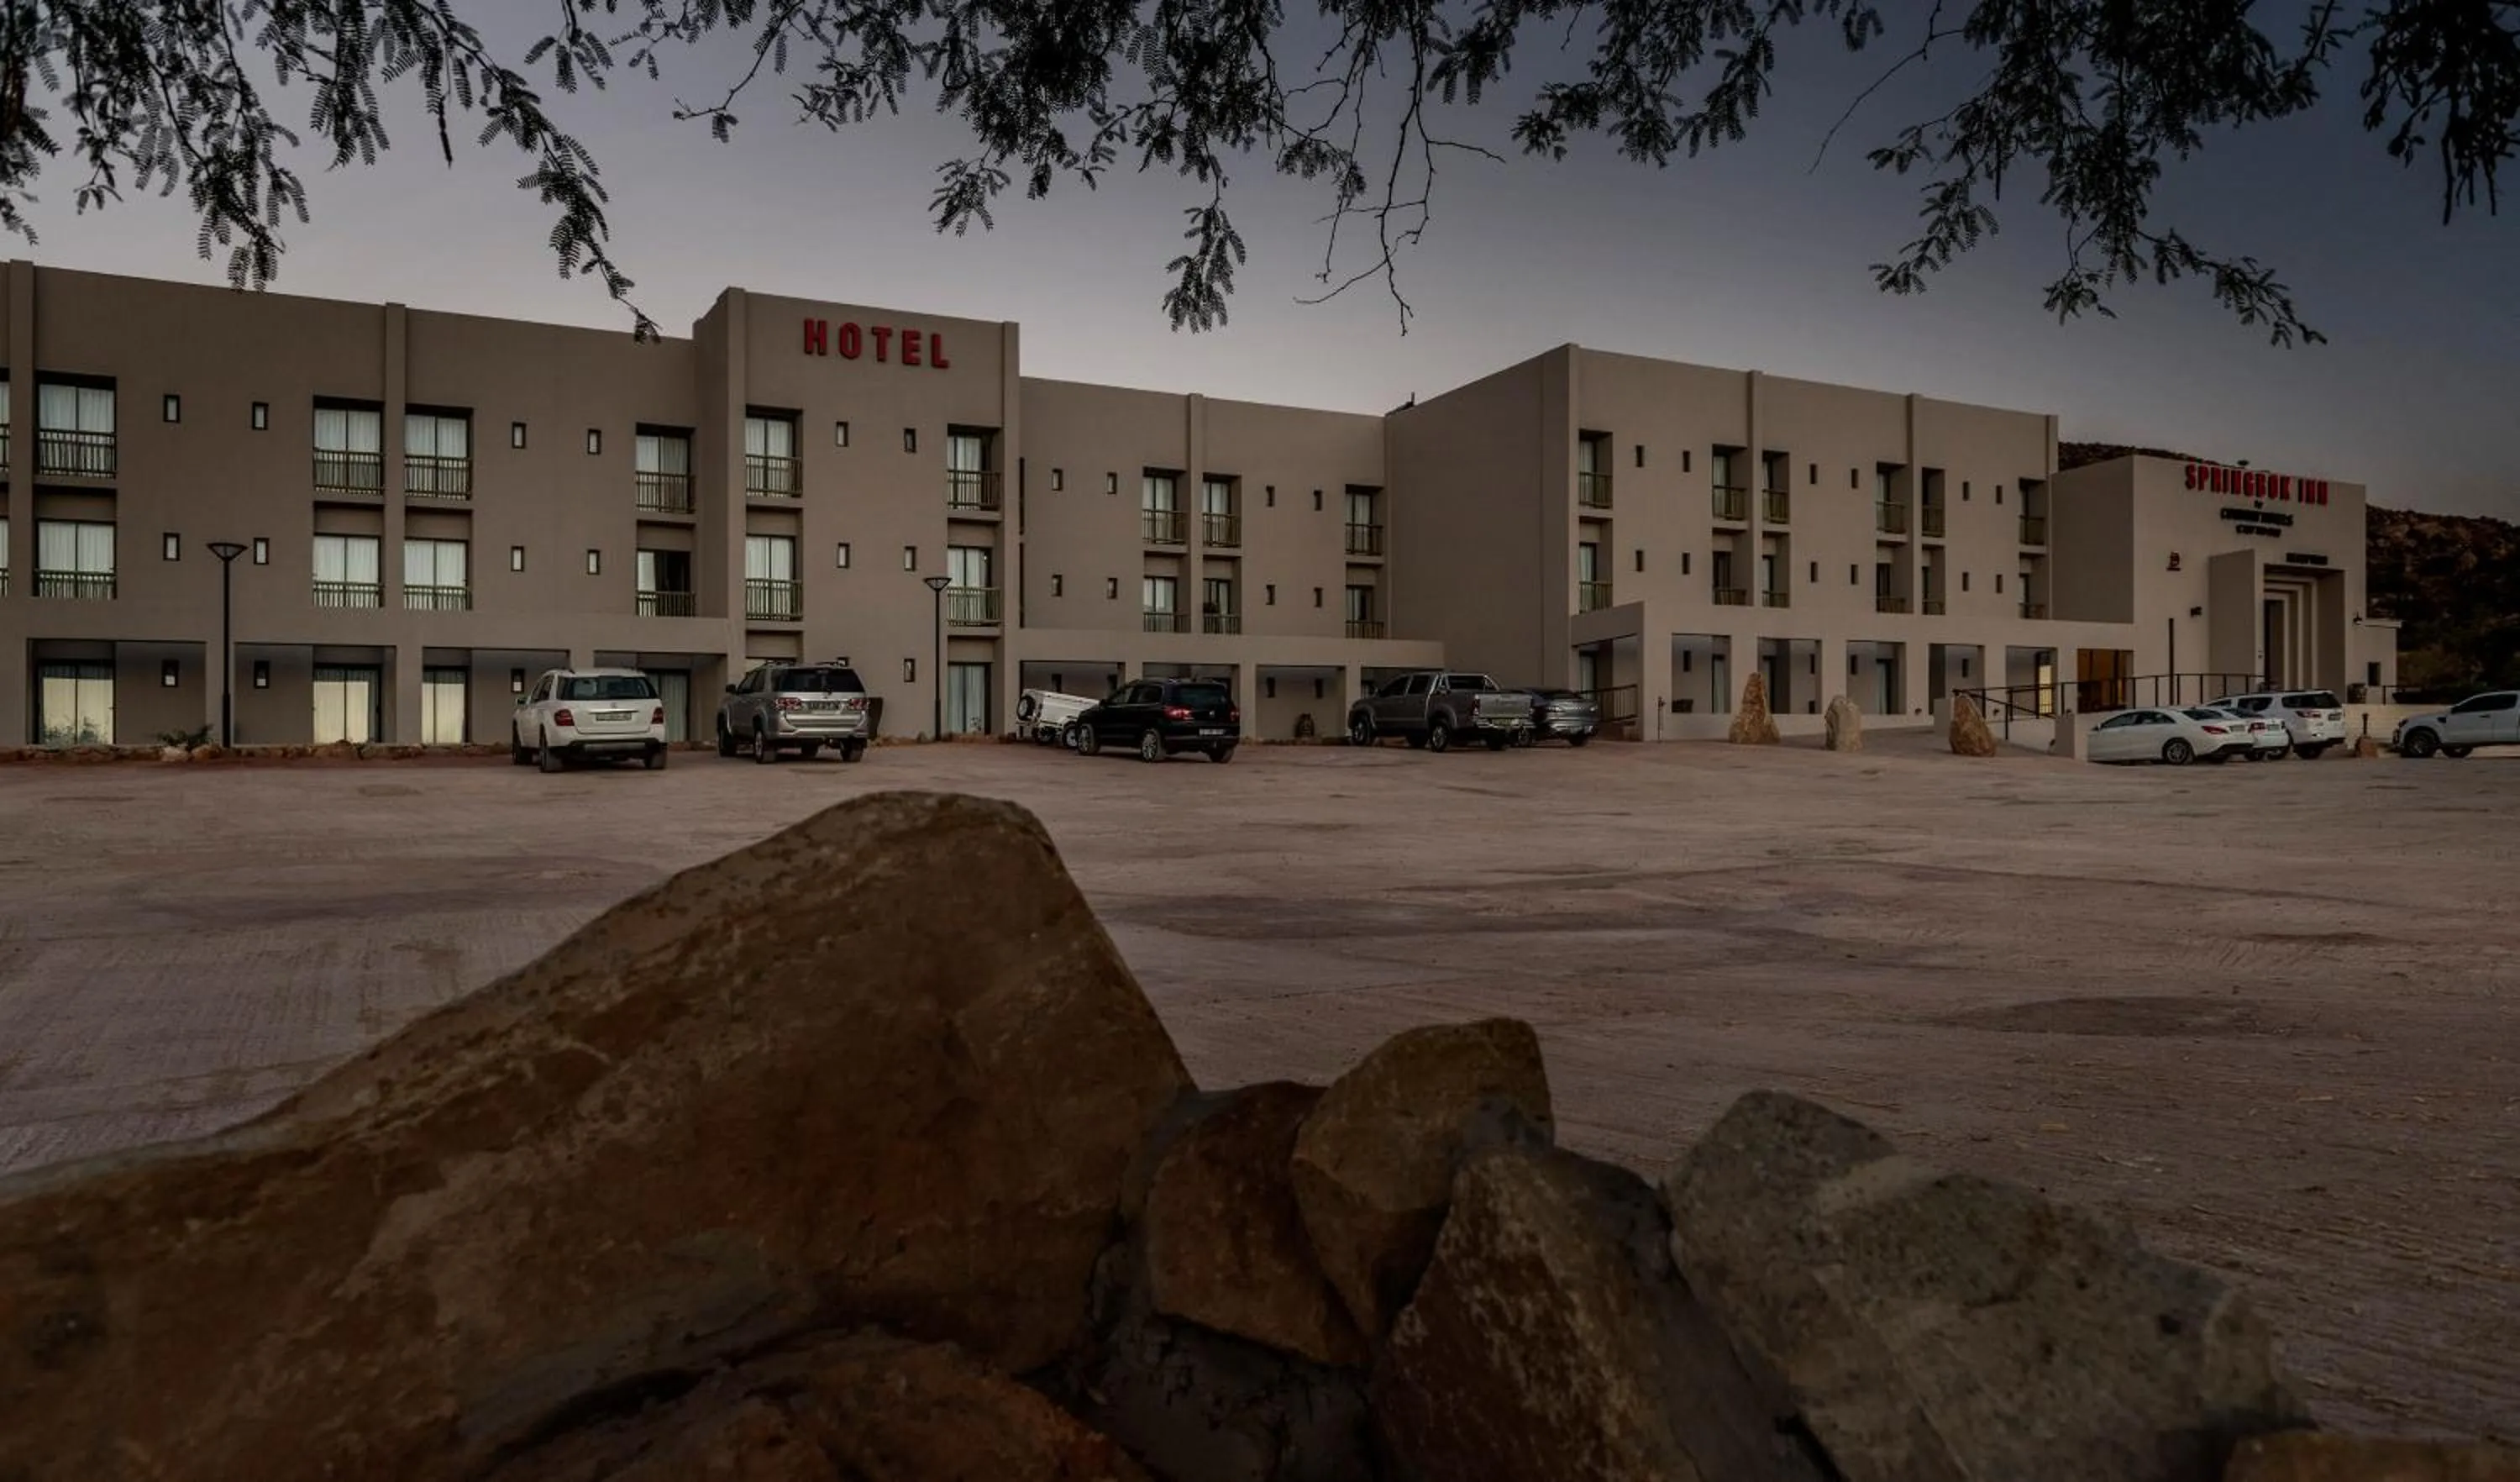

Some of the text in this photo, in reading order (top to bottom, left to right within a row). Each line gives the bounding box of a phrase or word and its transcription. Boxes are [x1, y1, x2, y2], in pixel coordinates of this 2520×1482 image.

[804, 319, 949, 369] HOTEL
[2185, 464, 2328, 506] SPRINGBOK INN
